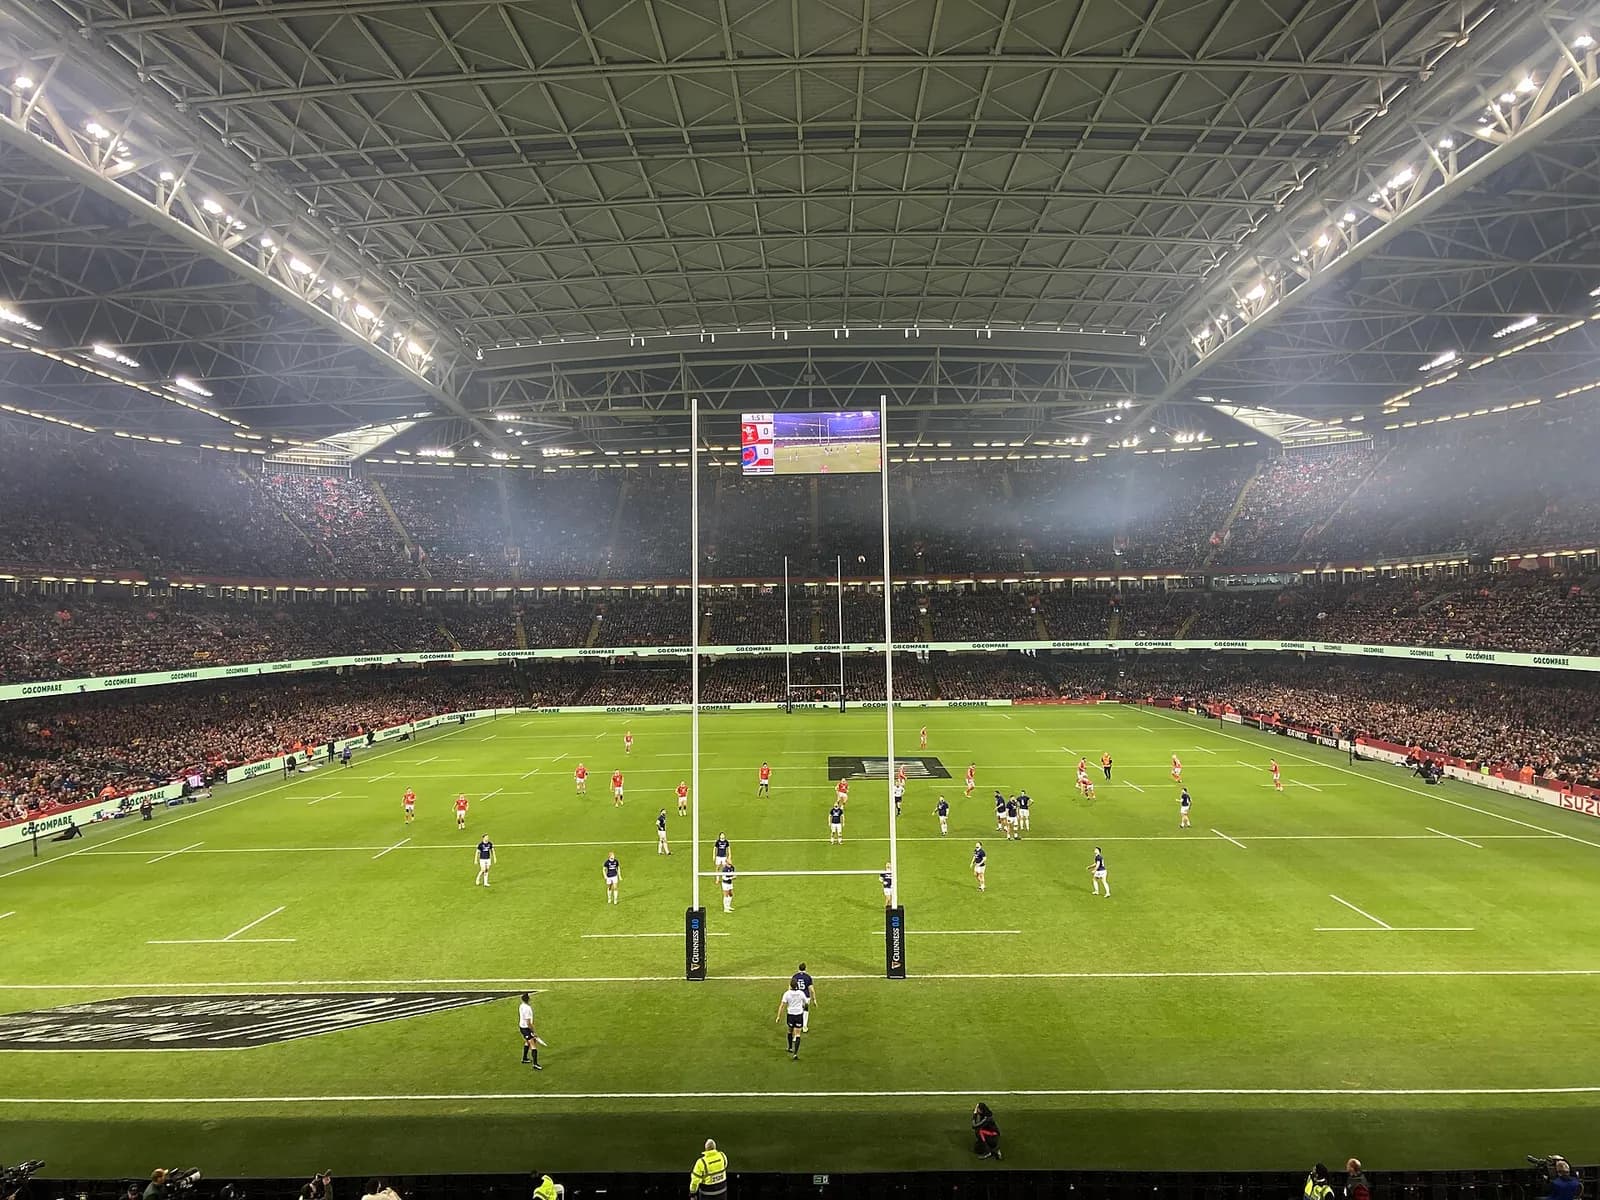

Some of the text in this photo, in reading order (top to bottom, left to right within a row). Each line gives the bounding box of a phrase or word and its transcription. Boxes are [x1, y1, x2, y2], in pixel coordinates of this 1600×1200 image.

[763, 427, 769, 435] 0
[763, 447, 769, 455] 0
[692, 930, 700, 963] GUINNESS
[892, 928, 900, 962] GUINNESS
[797, 981, 806, 990] 15
